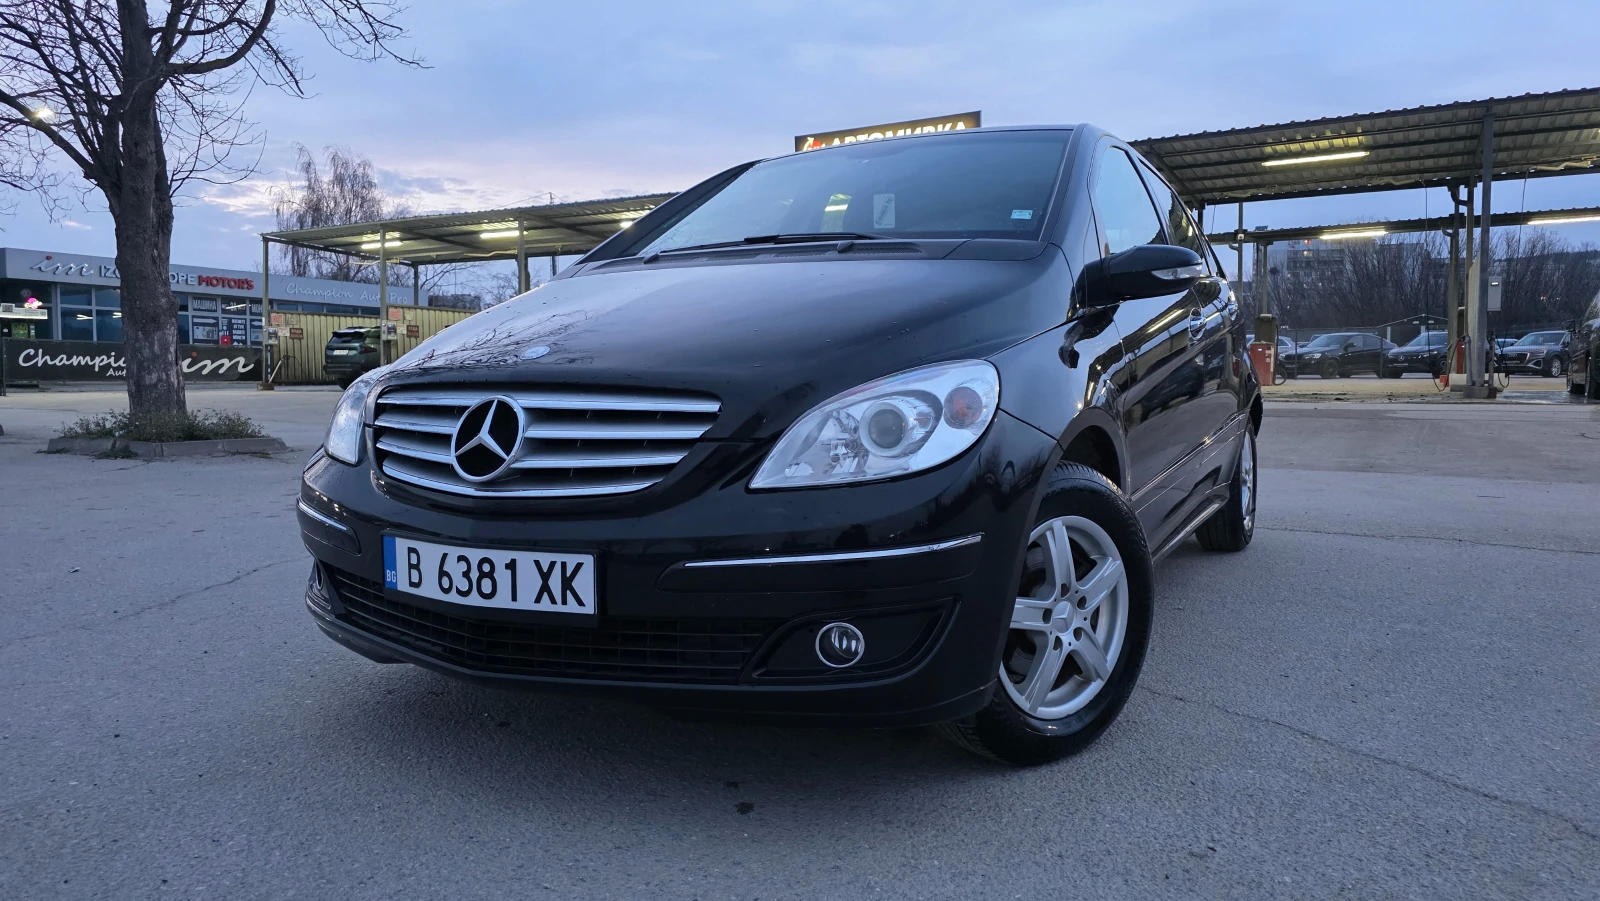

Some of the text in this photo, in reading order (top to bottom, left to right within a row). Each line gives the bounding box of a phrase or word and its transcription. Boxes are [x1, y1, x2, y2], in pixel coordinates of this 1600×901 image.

[169, 271, 197, 286] OPE
[286, 282, 408, 304] Champion Aut Pro
[386, 569, 397, 583] BG
[407, 546, 586, 607] B 6381 XK
